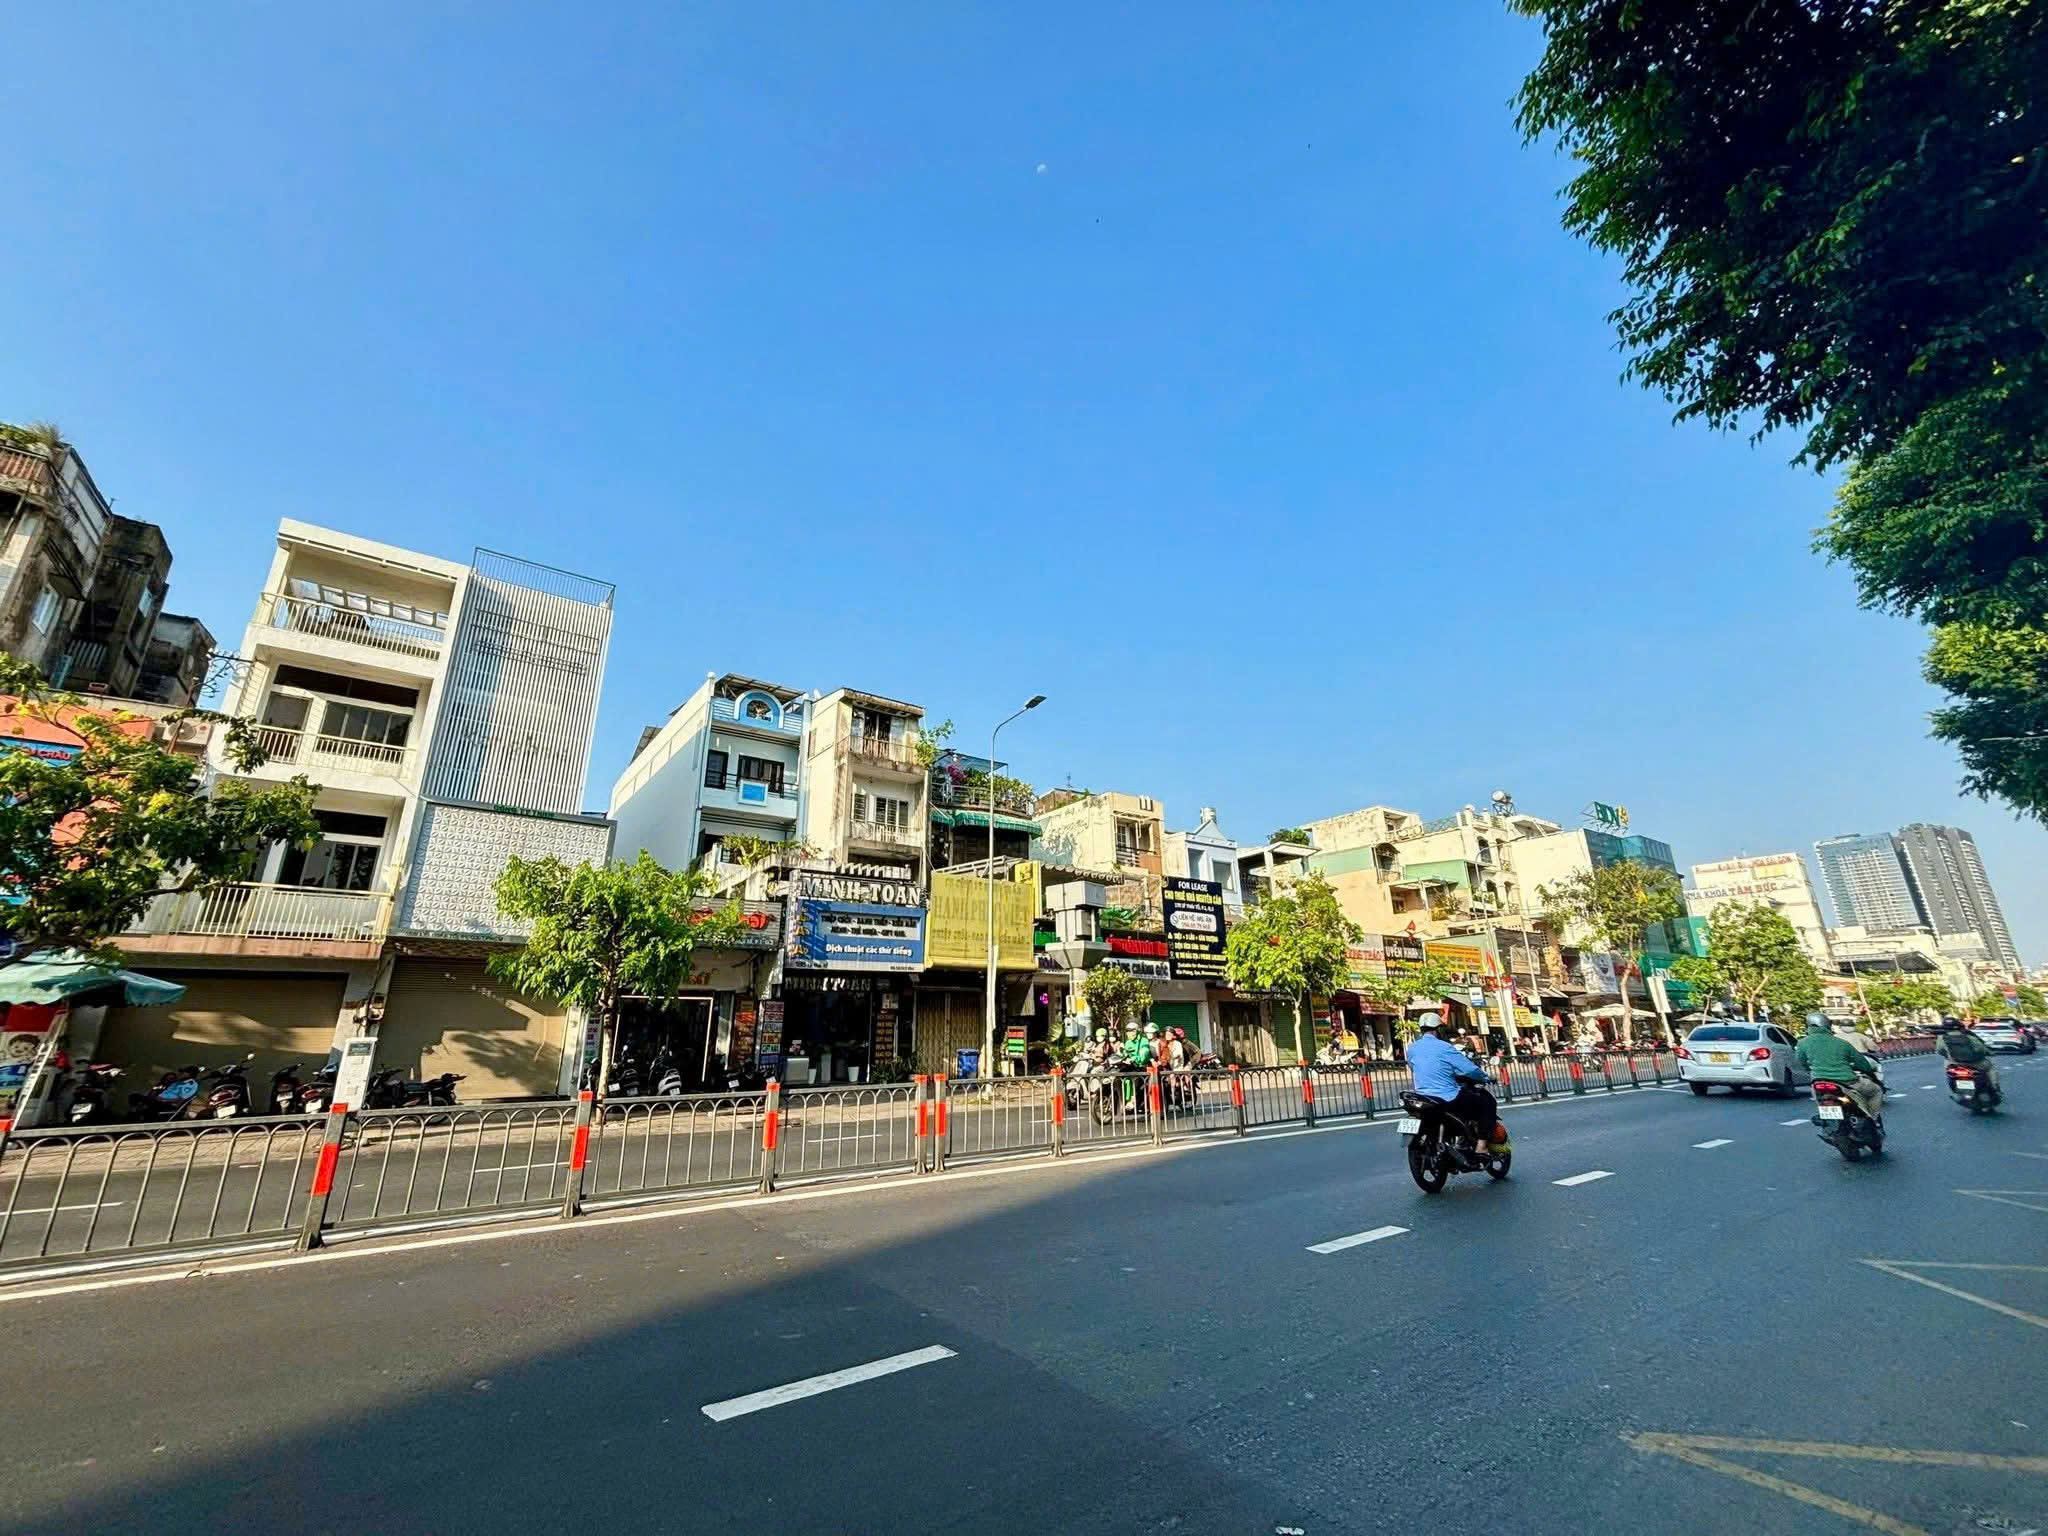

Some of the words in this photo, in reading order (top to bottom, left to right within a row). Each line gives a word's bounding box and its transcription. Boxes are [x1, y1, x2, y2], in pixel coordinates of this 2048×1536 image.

[801, 878, 860, 900] MINH
[1178, 881, 1190, 890] FOR
[1191, 882, 1208, 892] LEASE
[826, 943, 843, 955] Dịch
